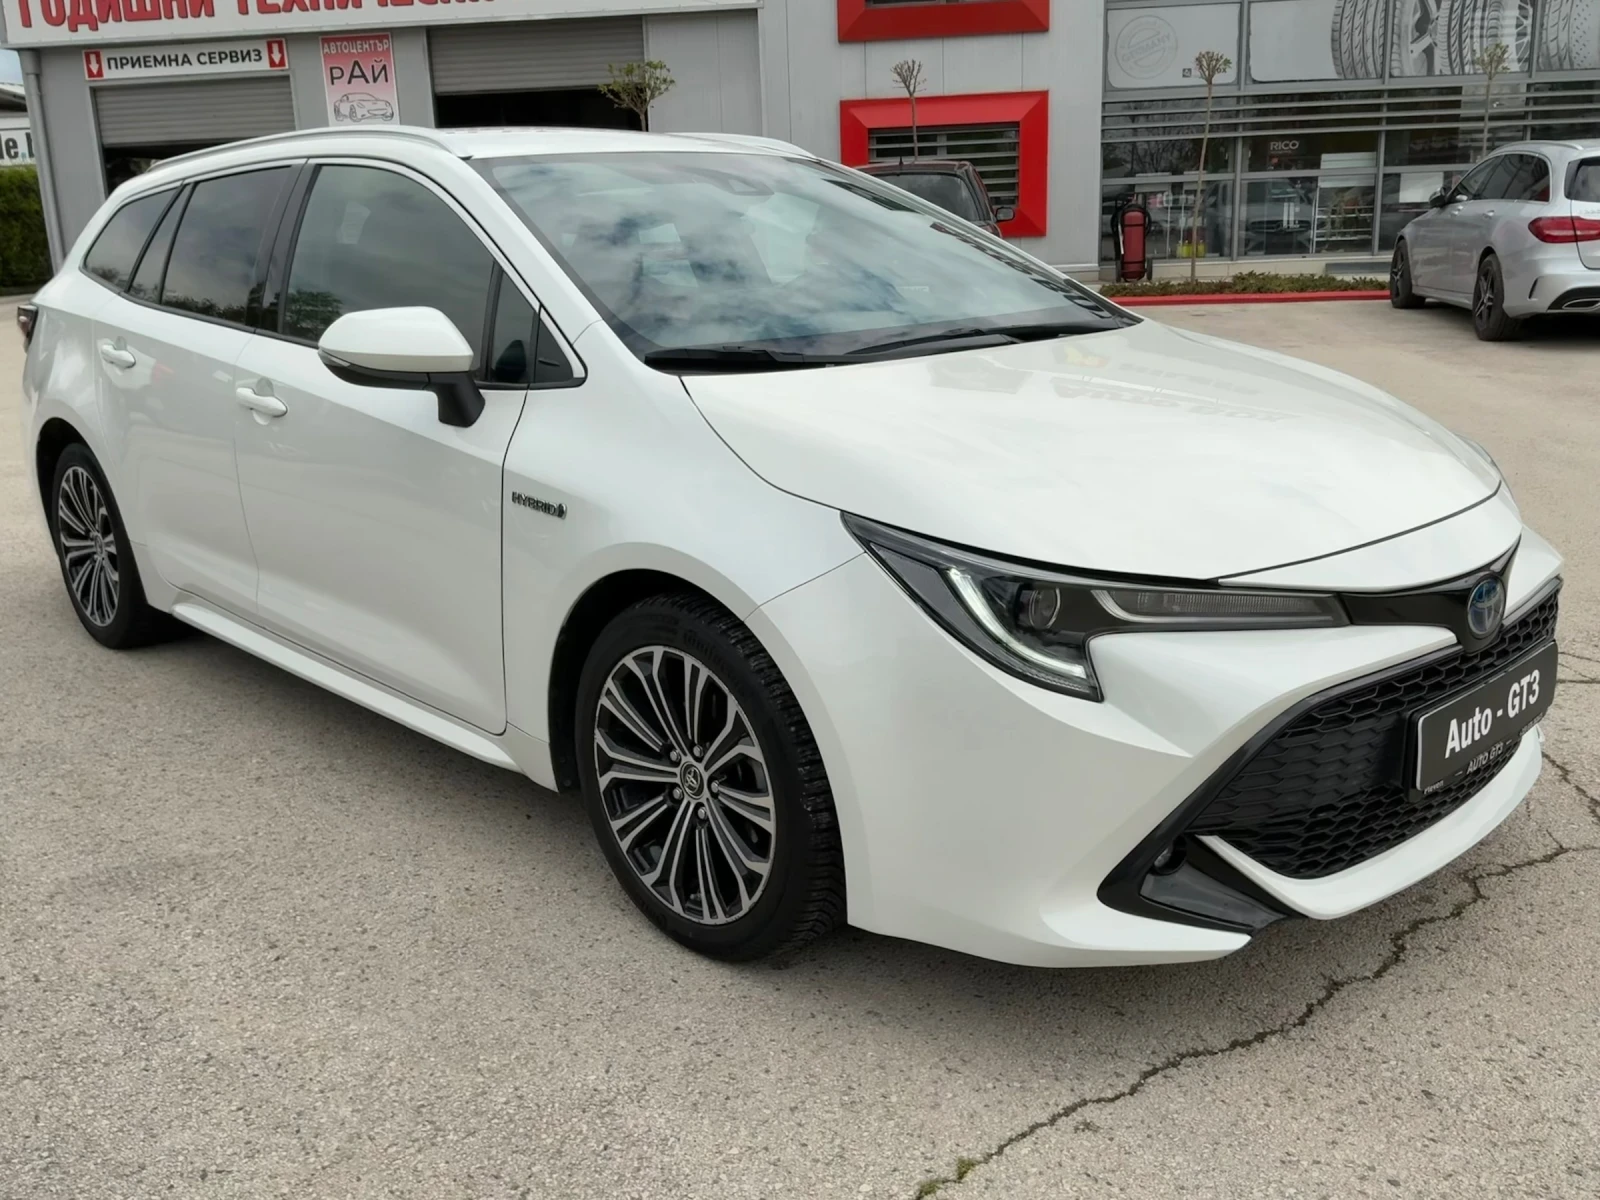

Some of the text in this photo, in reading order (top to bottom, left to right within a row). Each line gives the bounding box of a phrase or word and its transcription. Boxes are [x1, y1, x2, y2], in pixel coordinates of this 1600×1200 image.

[323, 39, 389, 55] АВТОЦЕНТЪР
[107, 48, 263, 70] ПРИЕМНА СЕРВИЗ
[329, 58, 389, 86] РАЙ
[1270, 140, 1300, 150] RICO
[511, 491, 557, 517] HYBRID
[1445, 706, 1493, 759] Auto
[1507, 669, 1541, 718] GT3
[1466, 752, 1489, 775] AUTO
